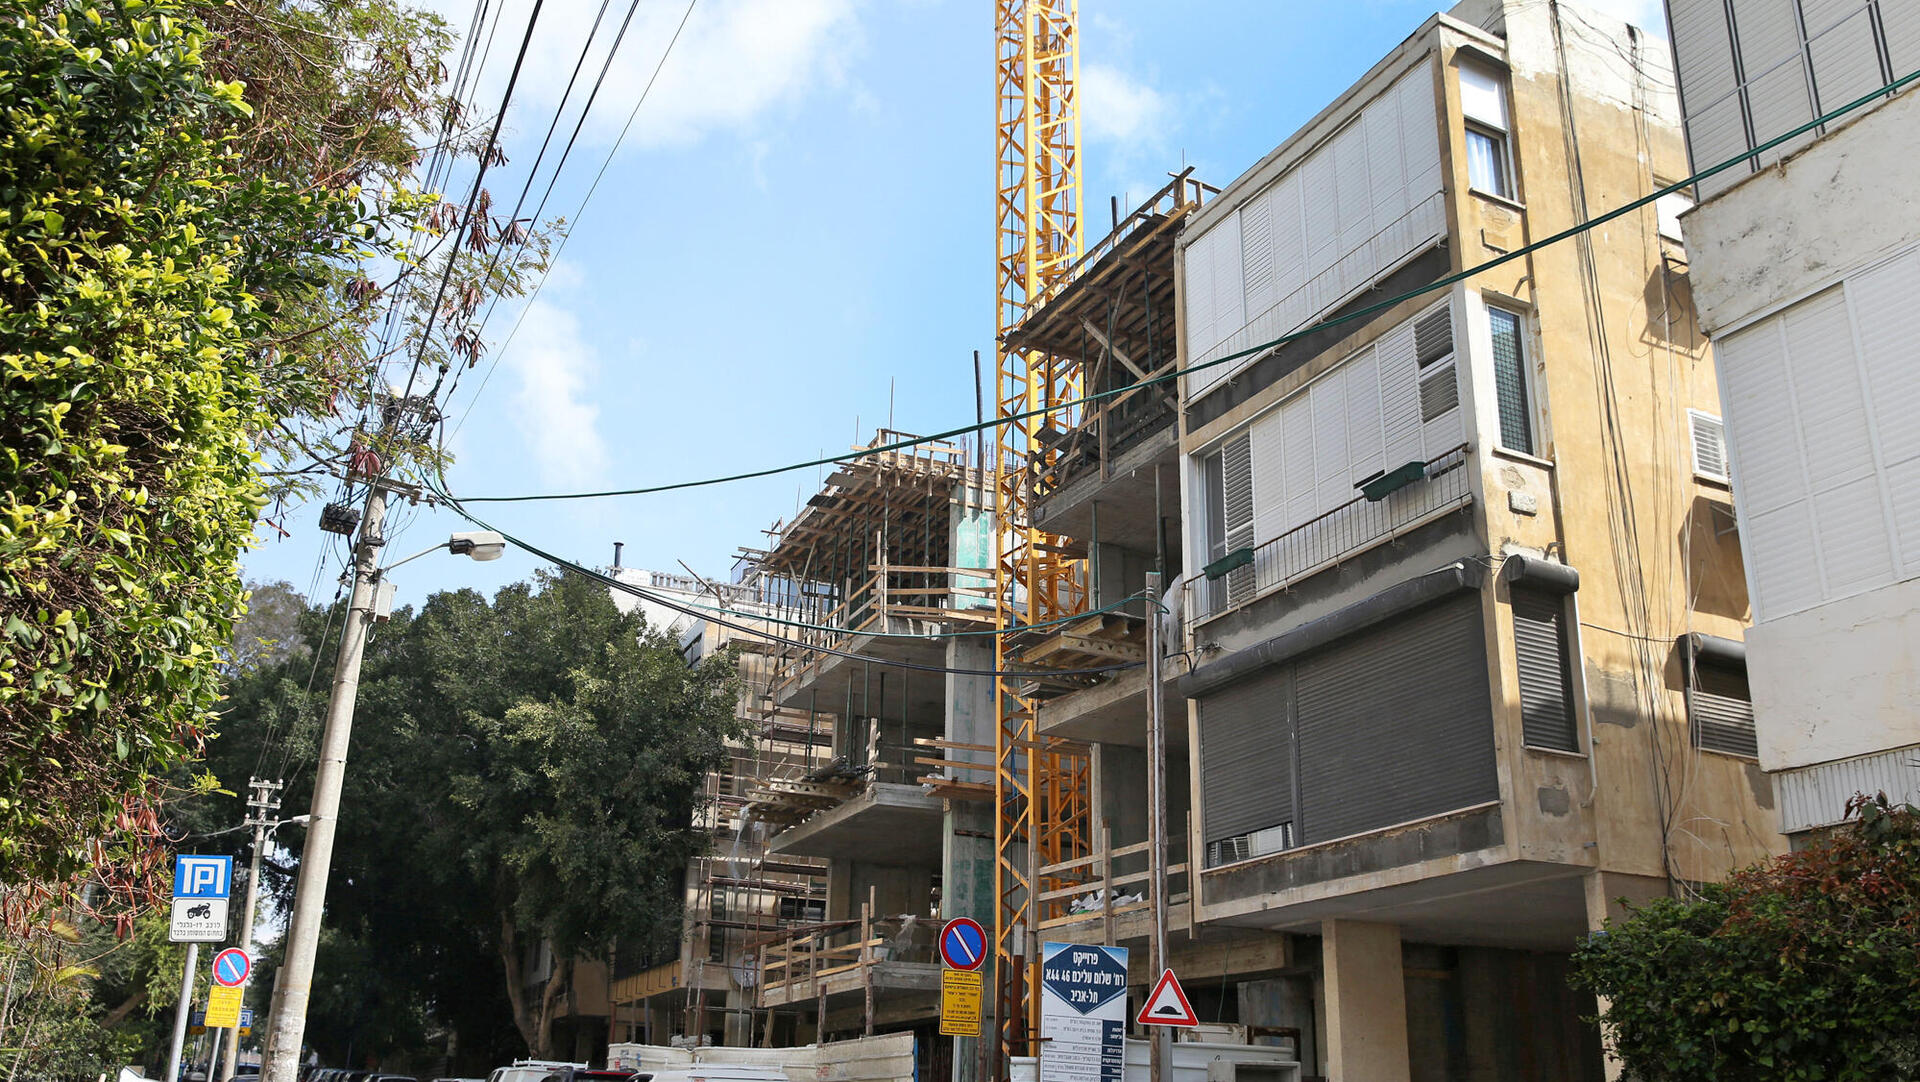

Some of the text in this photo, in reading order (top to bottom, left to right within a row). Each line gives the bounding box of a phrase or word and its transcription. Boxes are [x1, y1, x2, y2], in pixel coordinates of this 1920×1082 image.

[1073, 952, 1098, 966] פרוייקט
[1061, 969, 1070, 982] 46
[1072, 968, 1092, 984] עליכם
[1094, 970, 1112, 985] שלום
[1113, 973, 1124, 986] רח'
[1070, 988, 1098, 1004] תל-אביב
